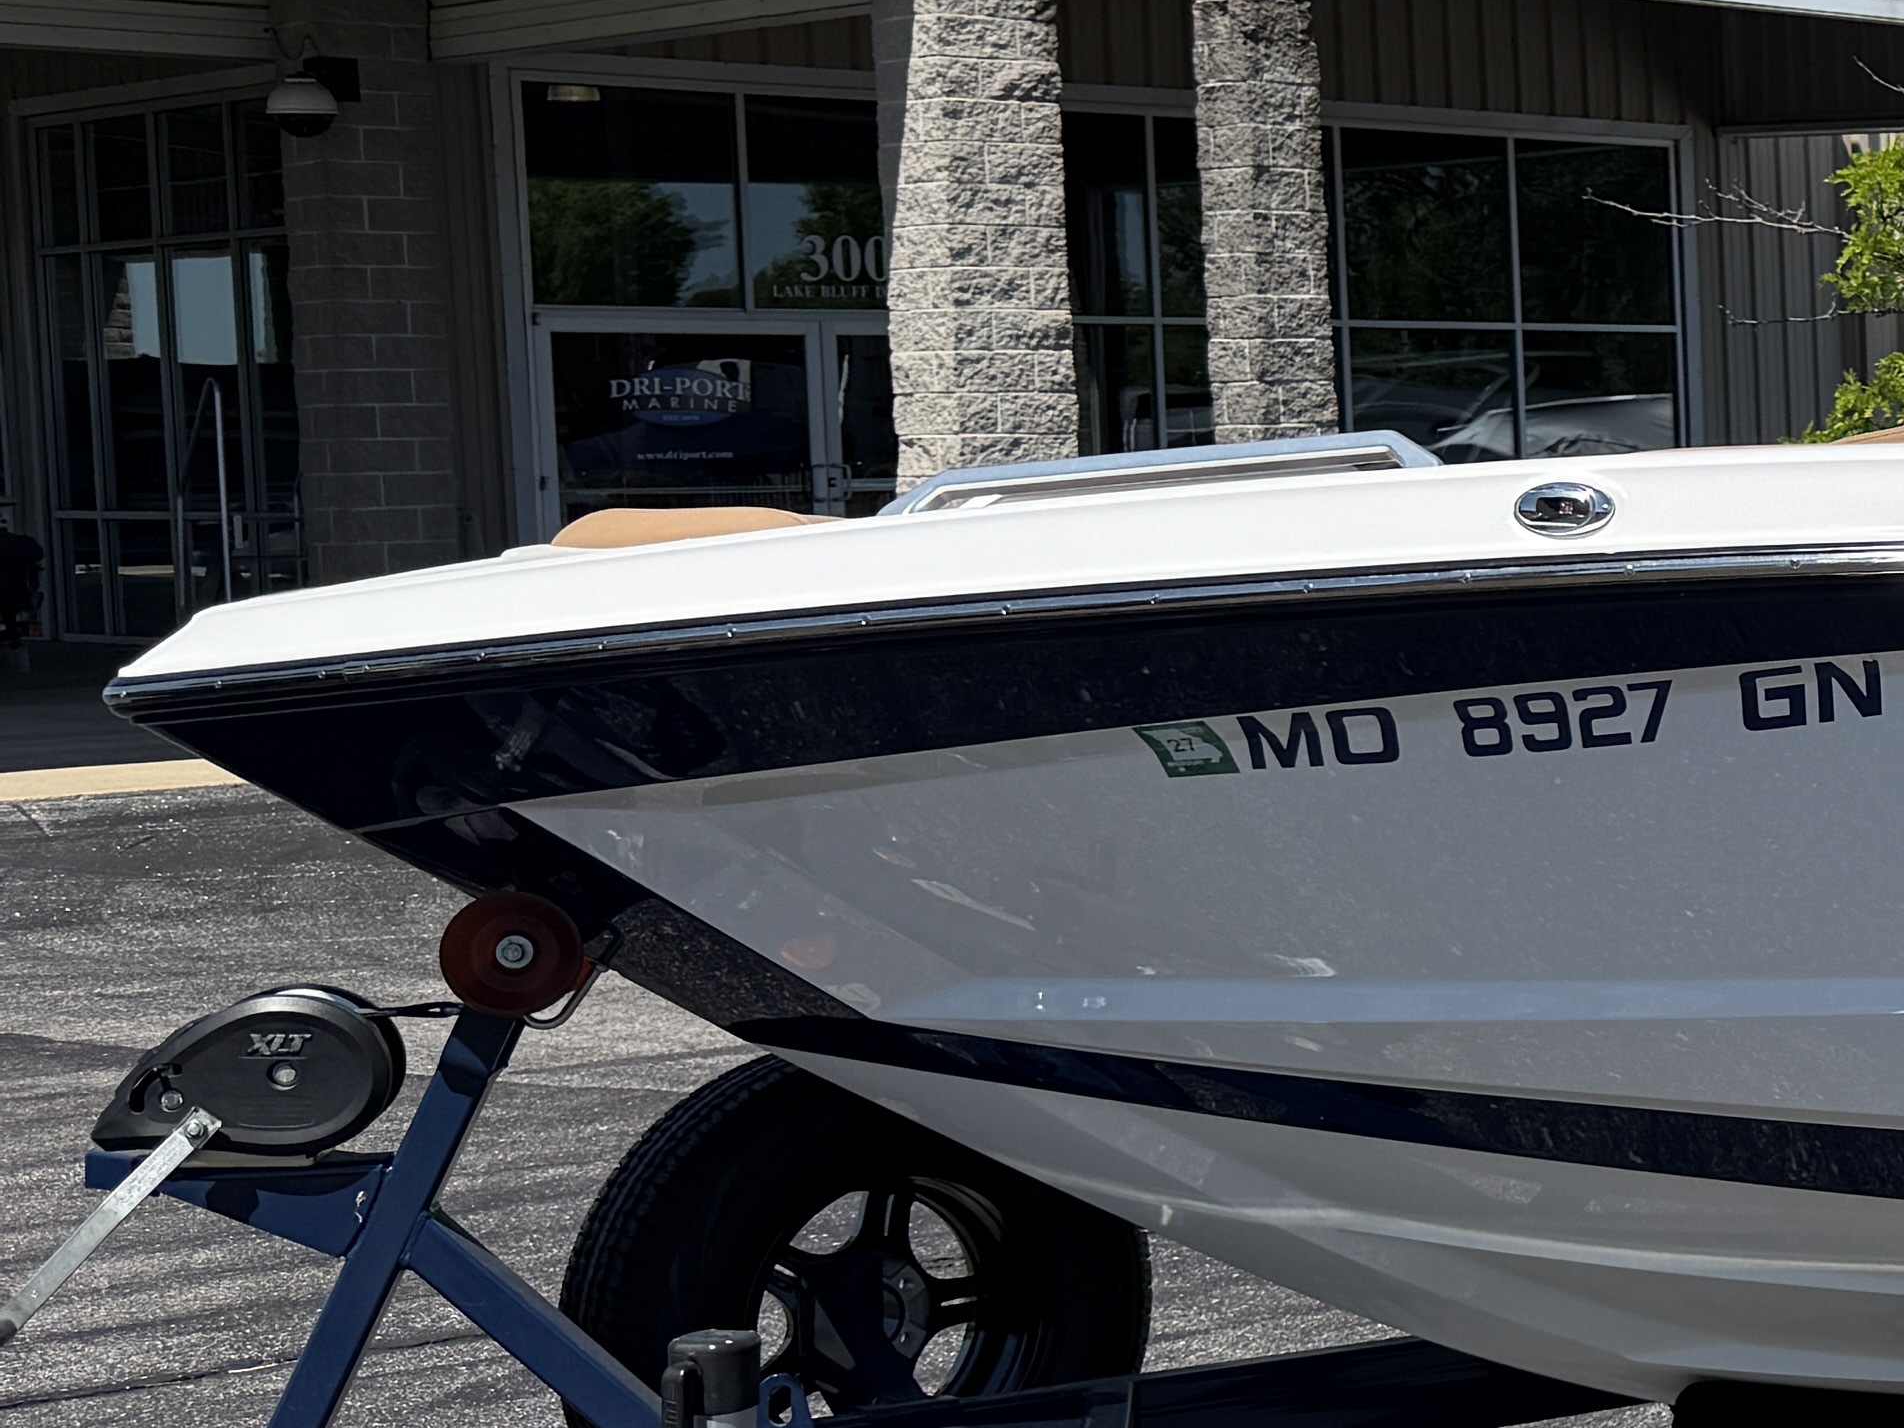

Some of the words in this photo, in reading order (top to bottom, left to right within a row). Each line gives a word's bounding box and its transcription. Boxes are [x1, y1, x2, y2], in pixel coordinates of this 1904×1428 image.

[800, 234, 888, 282] 300
[772, 284, 815, 298] LAKE
[821, 284, 869, 298] BLUFF
[608, 376, 746, 401] DRI-PORT
[622, 396, 739, 413] MARINE
[1236, 705, 1401, 771] MO
[1452, 679, 1673, 759] 8927
[1738, 658, 1884, 733] GN
[1166, 737, 1195, 753] 27
[247, 1033, 313, 1056] XLT
